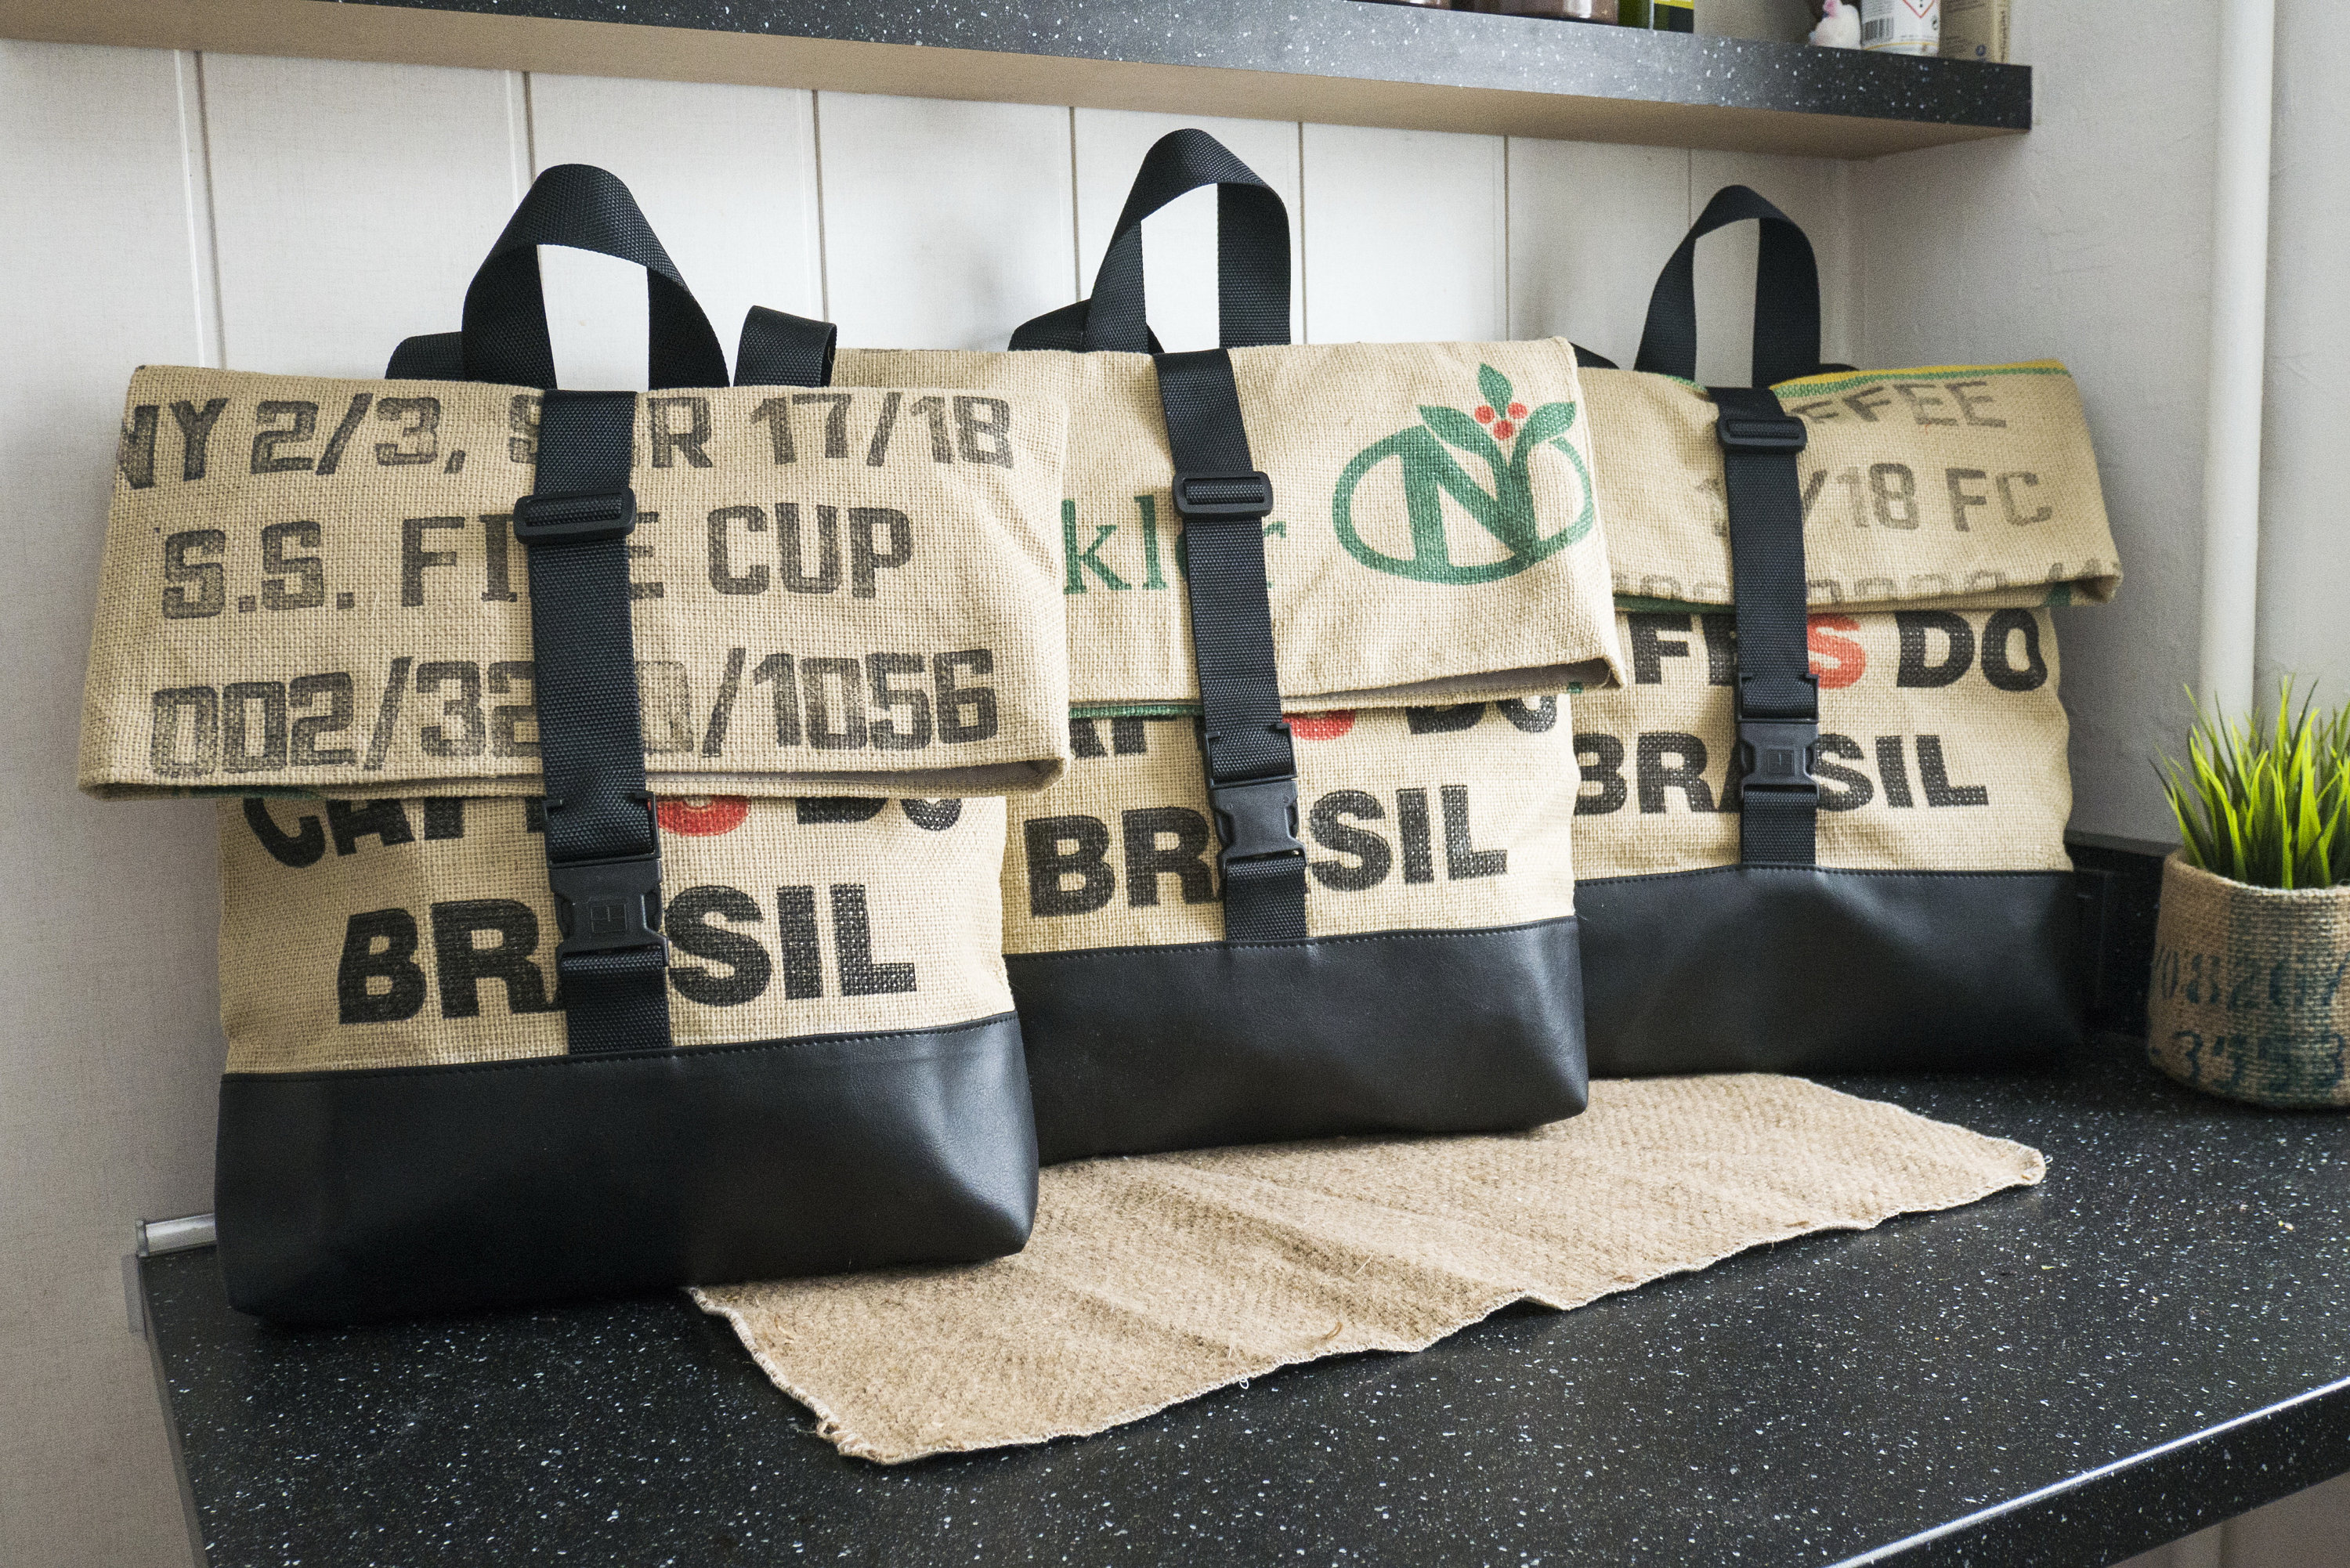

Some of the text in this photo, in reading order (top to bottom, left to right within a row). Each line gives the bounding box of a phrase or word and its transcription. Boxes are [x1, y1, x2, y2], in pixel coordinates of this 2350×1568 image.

[509, 395, 712, 468] SR
[750, 392, 1014, 468] 17/18
[1945, 468, 2052, 532] FC
[162, 520, 354, 620] S.S.
[707, 502, 913, 598] CUP
[1896, 608, 2048, 692] DO
[1025, 784, 1507, 918] BRSIL
[338, 883, 917, 1024] BRSIL
